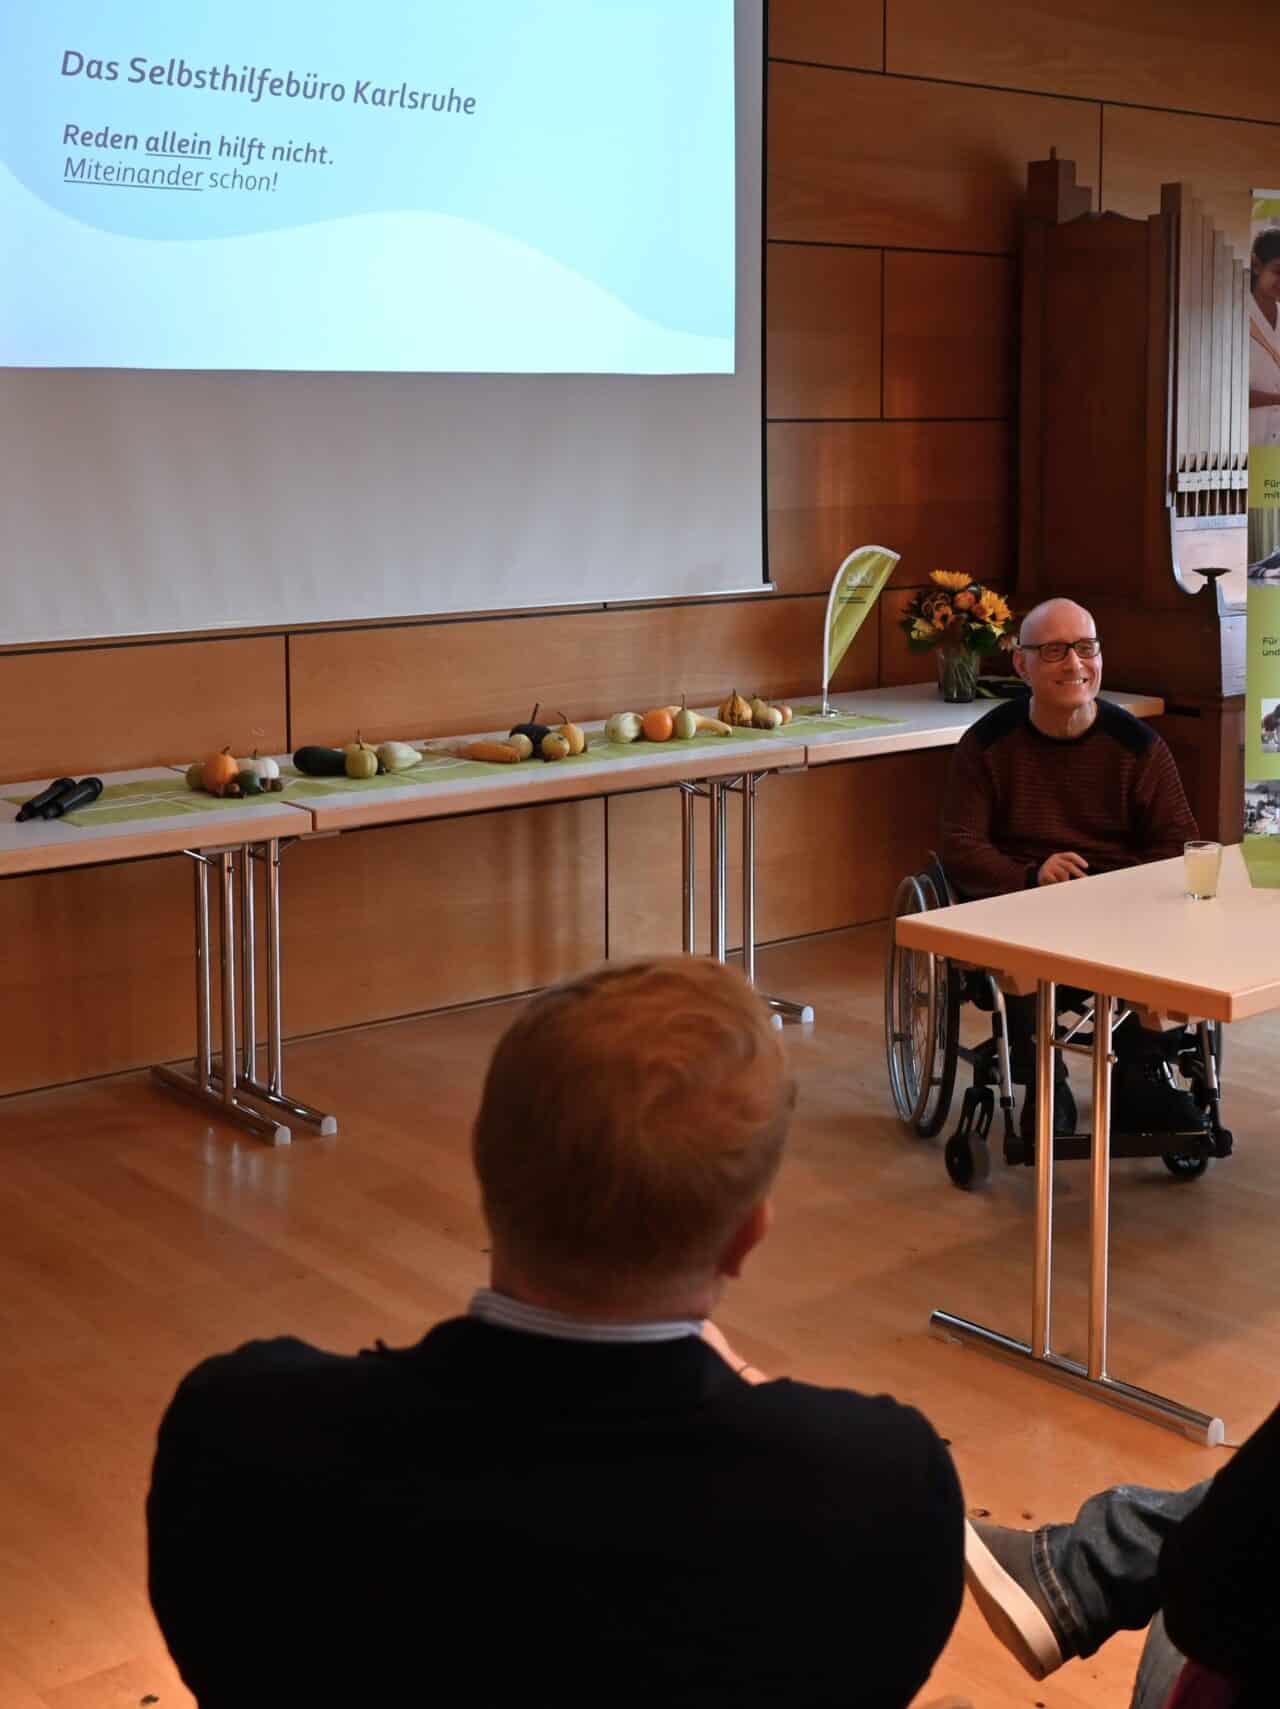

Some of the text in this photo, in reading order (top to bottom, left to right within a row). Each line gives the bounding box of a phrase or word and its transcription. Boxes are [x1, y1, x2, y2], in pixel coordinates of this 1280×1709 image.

[61, 50, 477, 115] Das Selbsthilfebüro Karlsruhe
[63, 123, 334, 166] Reden allein hilft nicht.
[64, 157, 278, 192] Miteinander schon!
[1263, 478, 1280, 488] Für
[1263, 490, 1280, 499] mit
[1262, 636, 1278, 645] Für
[1262, 647, 1280, 656] und
